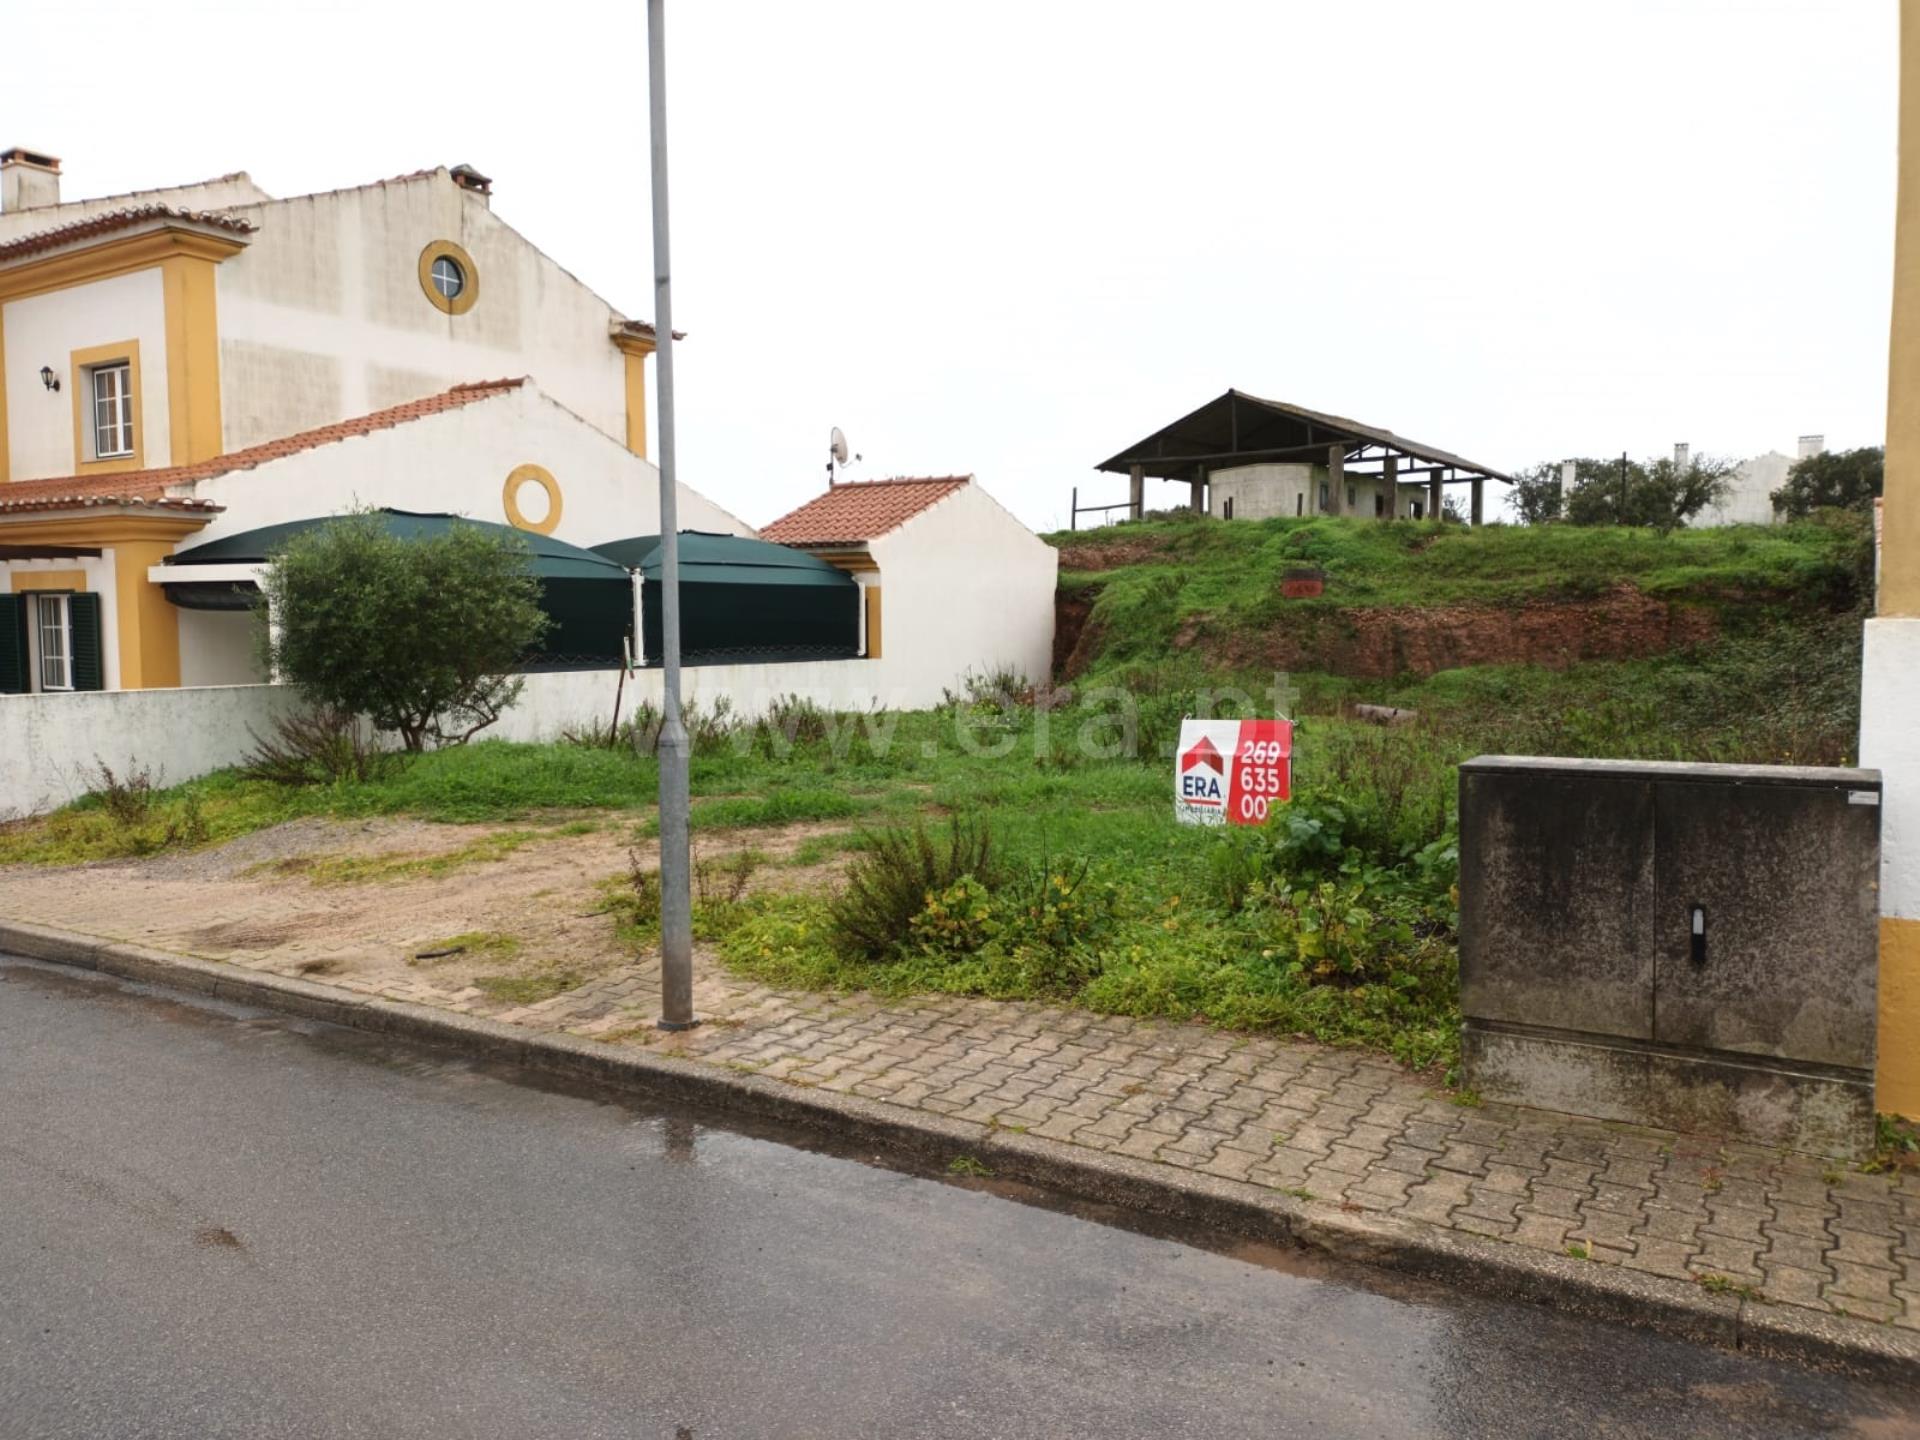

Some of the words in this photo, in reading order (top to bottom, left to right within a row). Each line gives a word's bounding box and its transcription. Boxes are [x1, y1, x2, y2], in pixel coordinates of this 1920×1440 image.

[1241, 740, 1280, 765] 269
[1183, 775, 1221, 798] ERA
[1241, 766, 1280, 793] 635
[1241, 793, 1278, 819] 00
